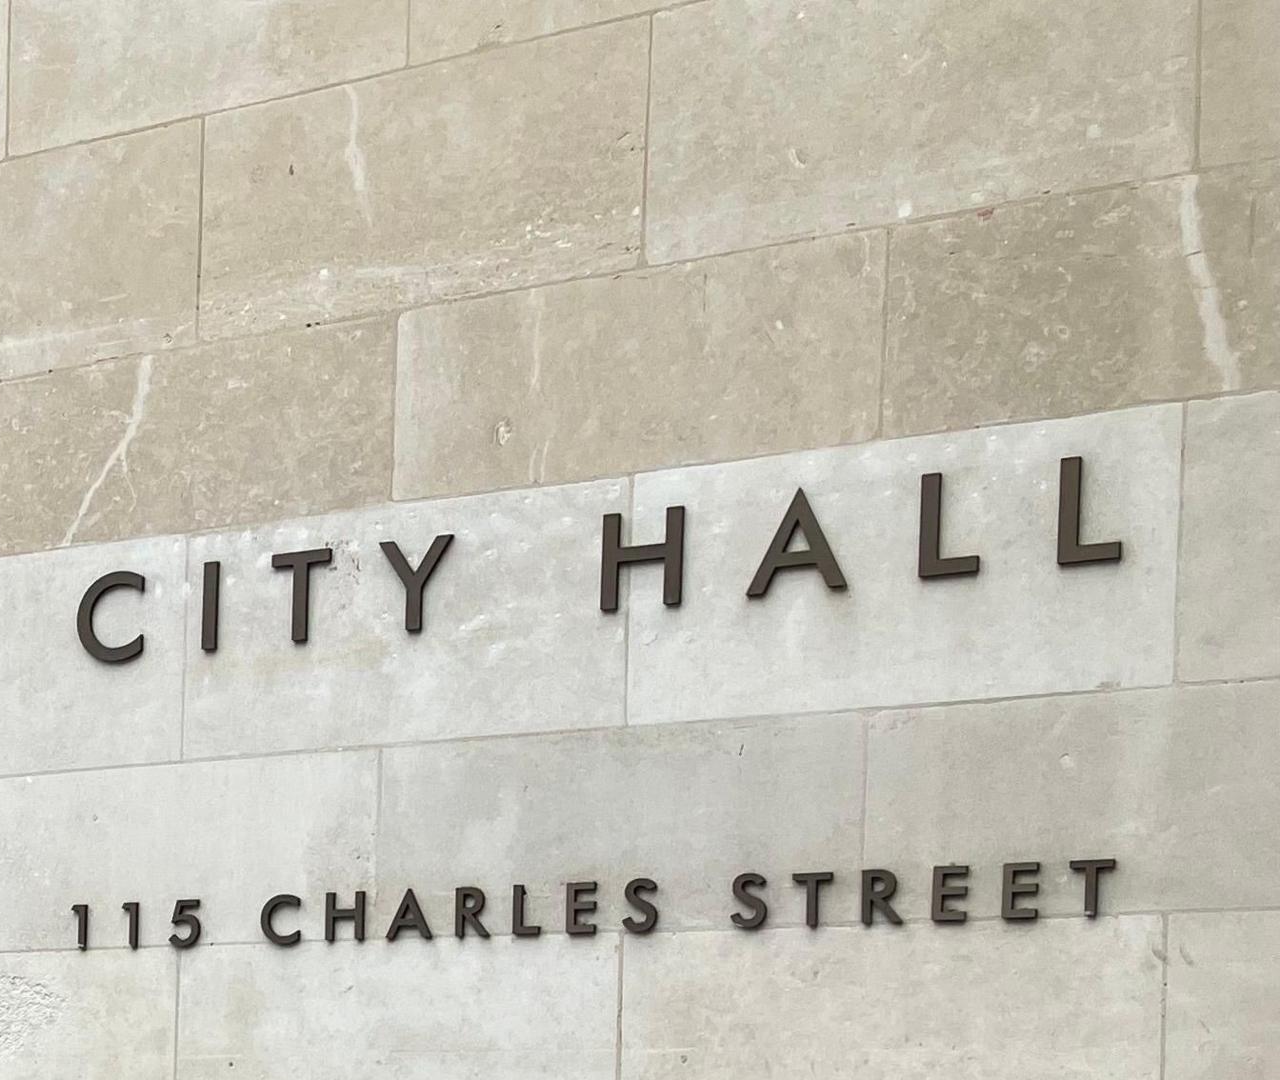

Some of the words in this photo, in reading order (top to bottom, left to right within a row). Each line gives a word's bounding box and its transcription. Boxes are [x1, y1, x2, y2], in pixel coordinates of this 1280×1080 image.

[76, 534, 455, 667] CITY
[599, 455, 1124, 615] HALL
[71, 899, 202, 952] 115
[260, 877, 660, 949] CHARLES
[730, 858, 1118, 933] STREET
